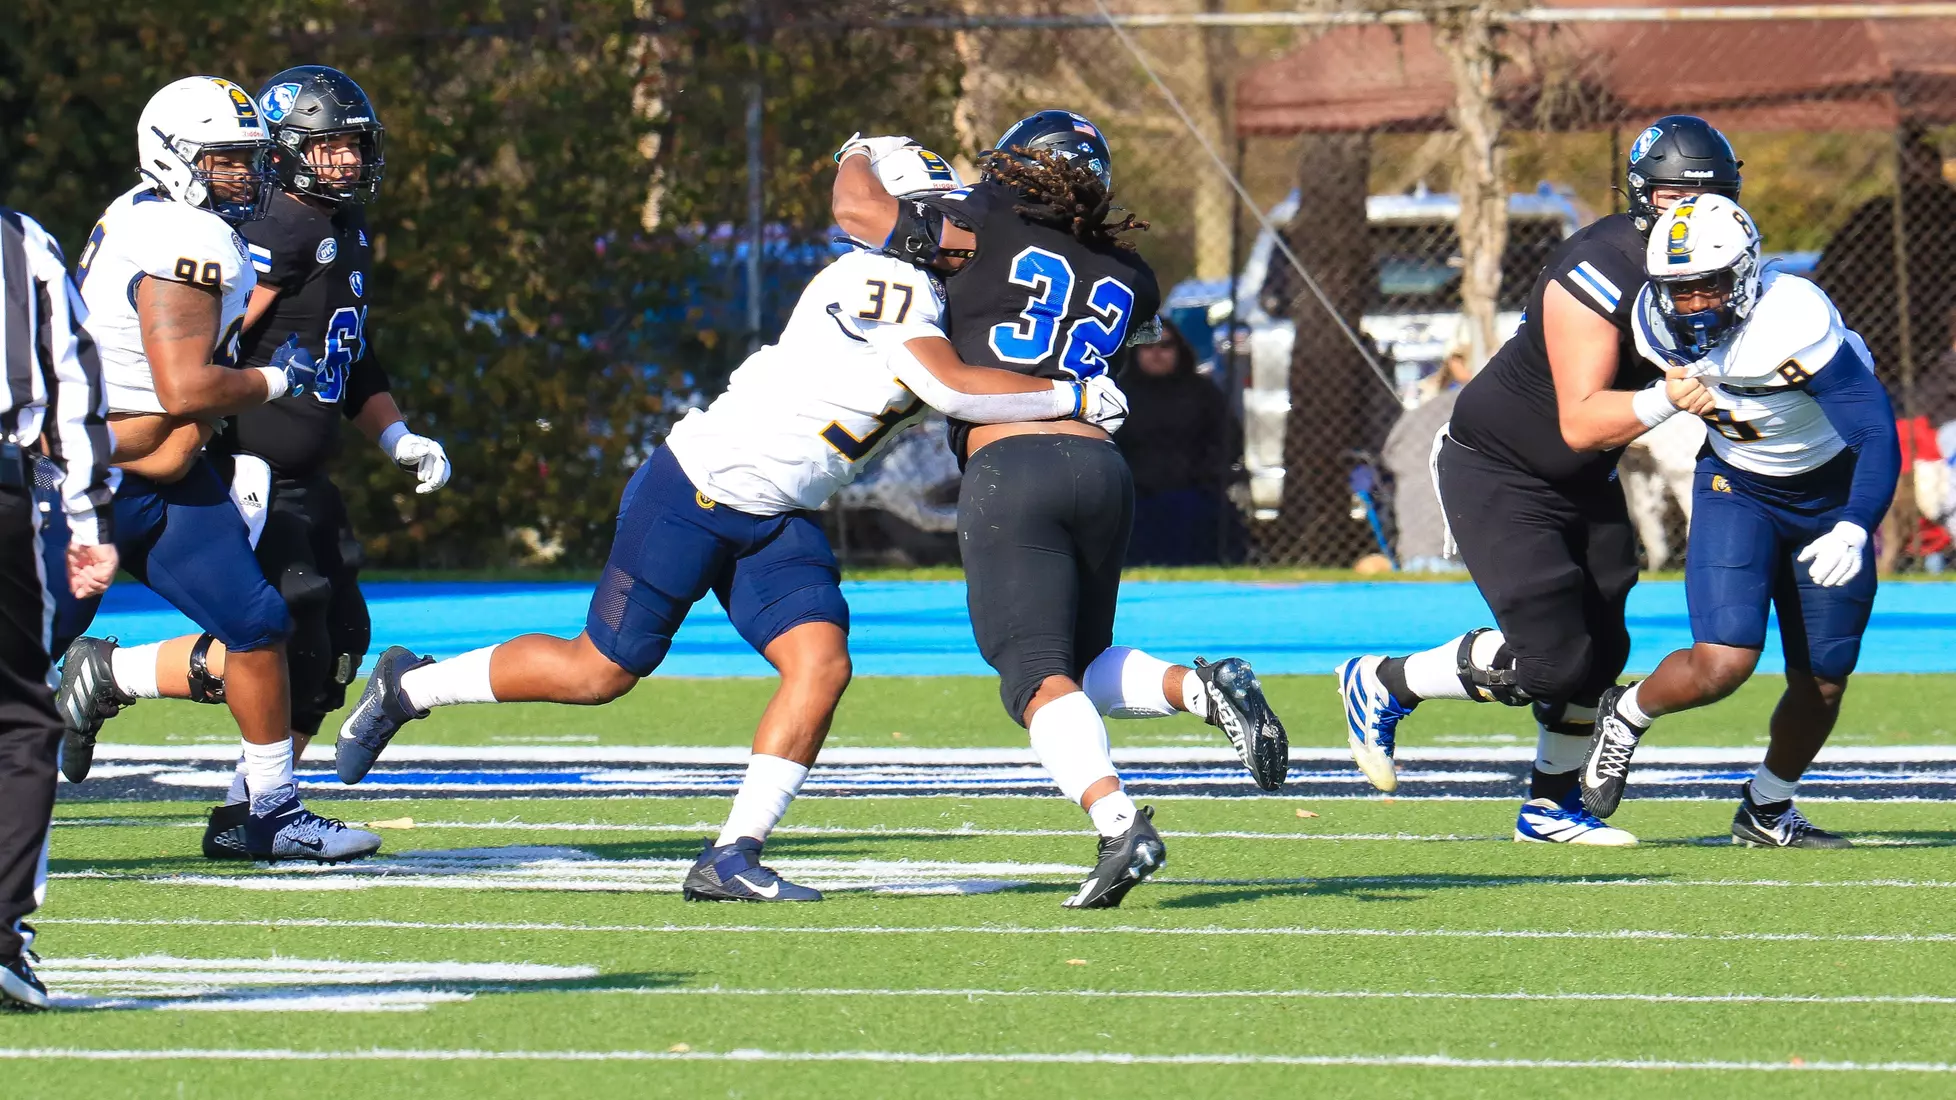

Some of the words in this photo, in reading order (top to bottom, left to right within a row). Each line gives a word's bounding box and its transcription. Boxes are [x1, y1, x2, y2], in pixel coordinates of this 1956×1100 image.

[1732, 210, 1754, 239] 8
[174, 256, 222, 289] 99
[859, 278, 914, 324] 37
[988, 245, 1135, 381] 32
[240, 500, 262, 509] adidas
